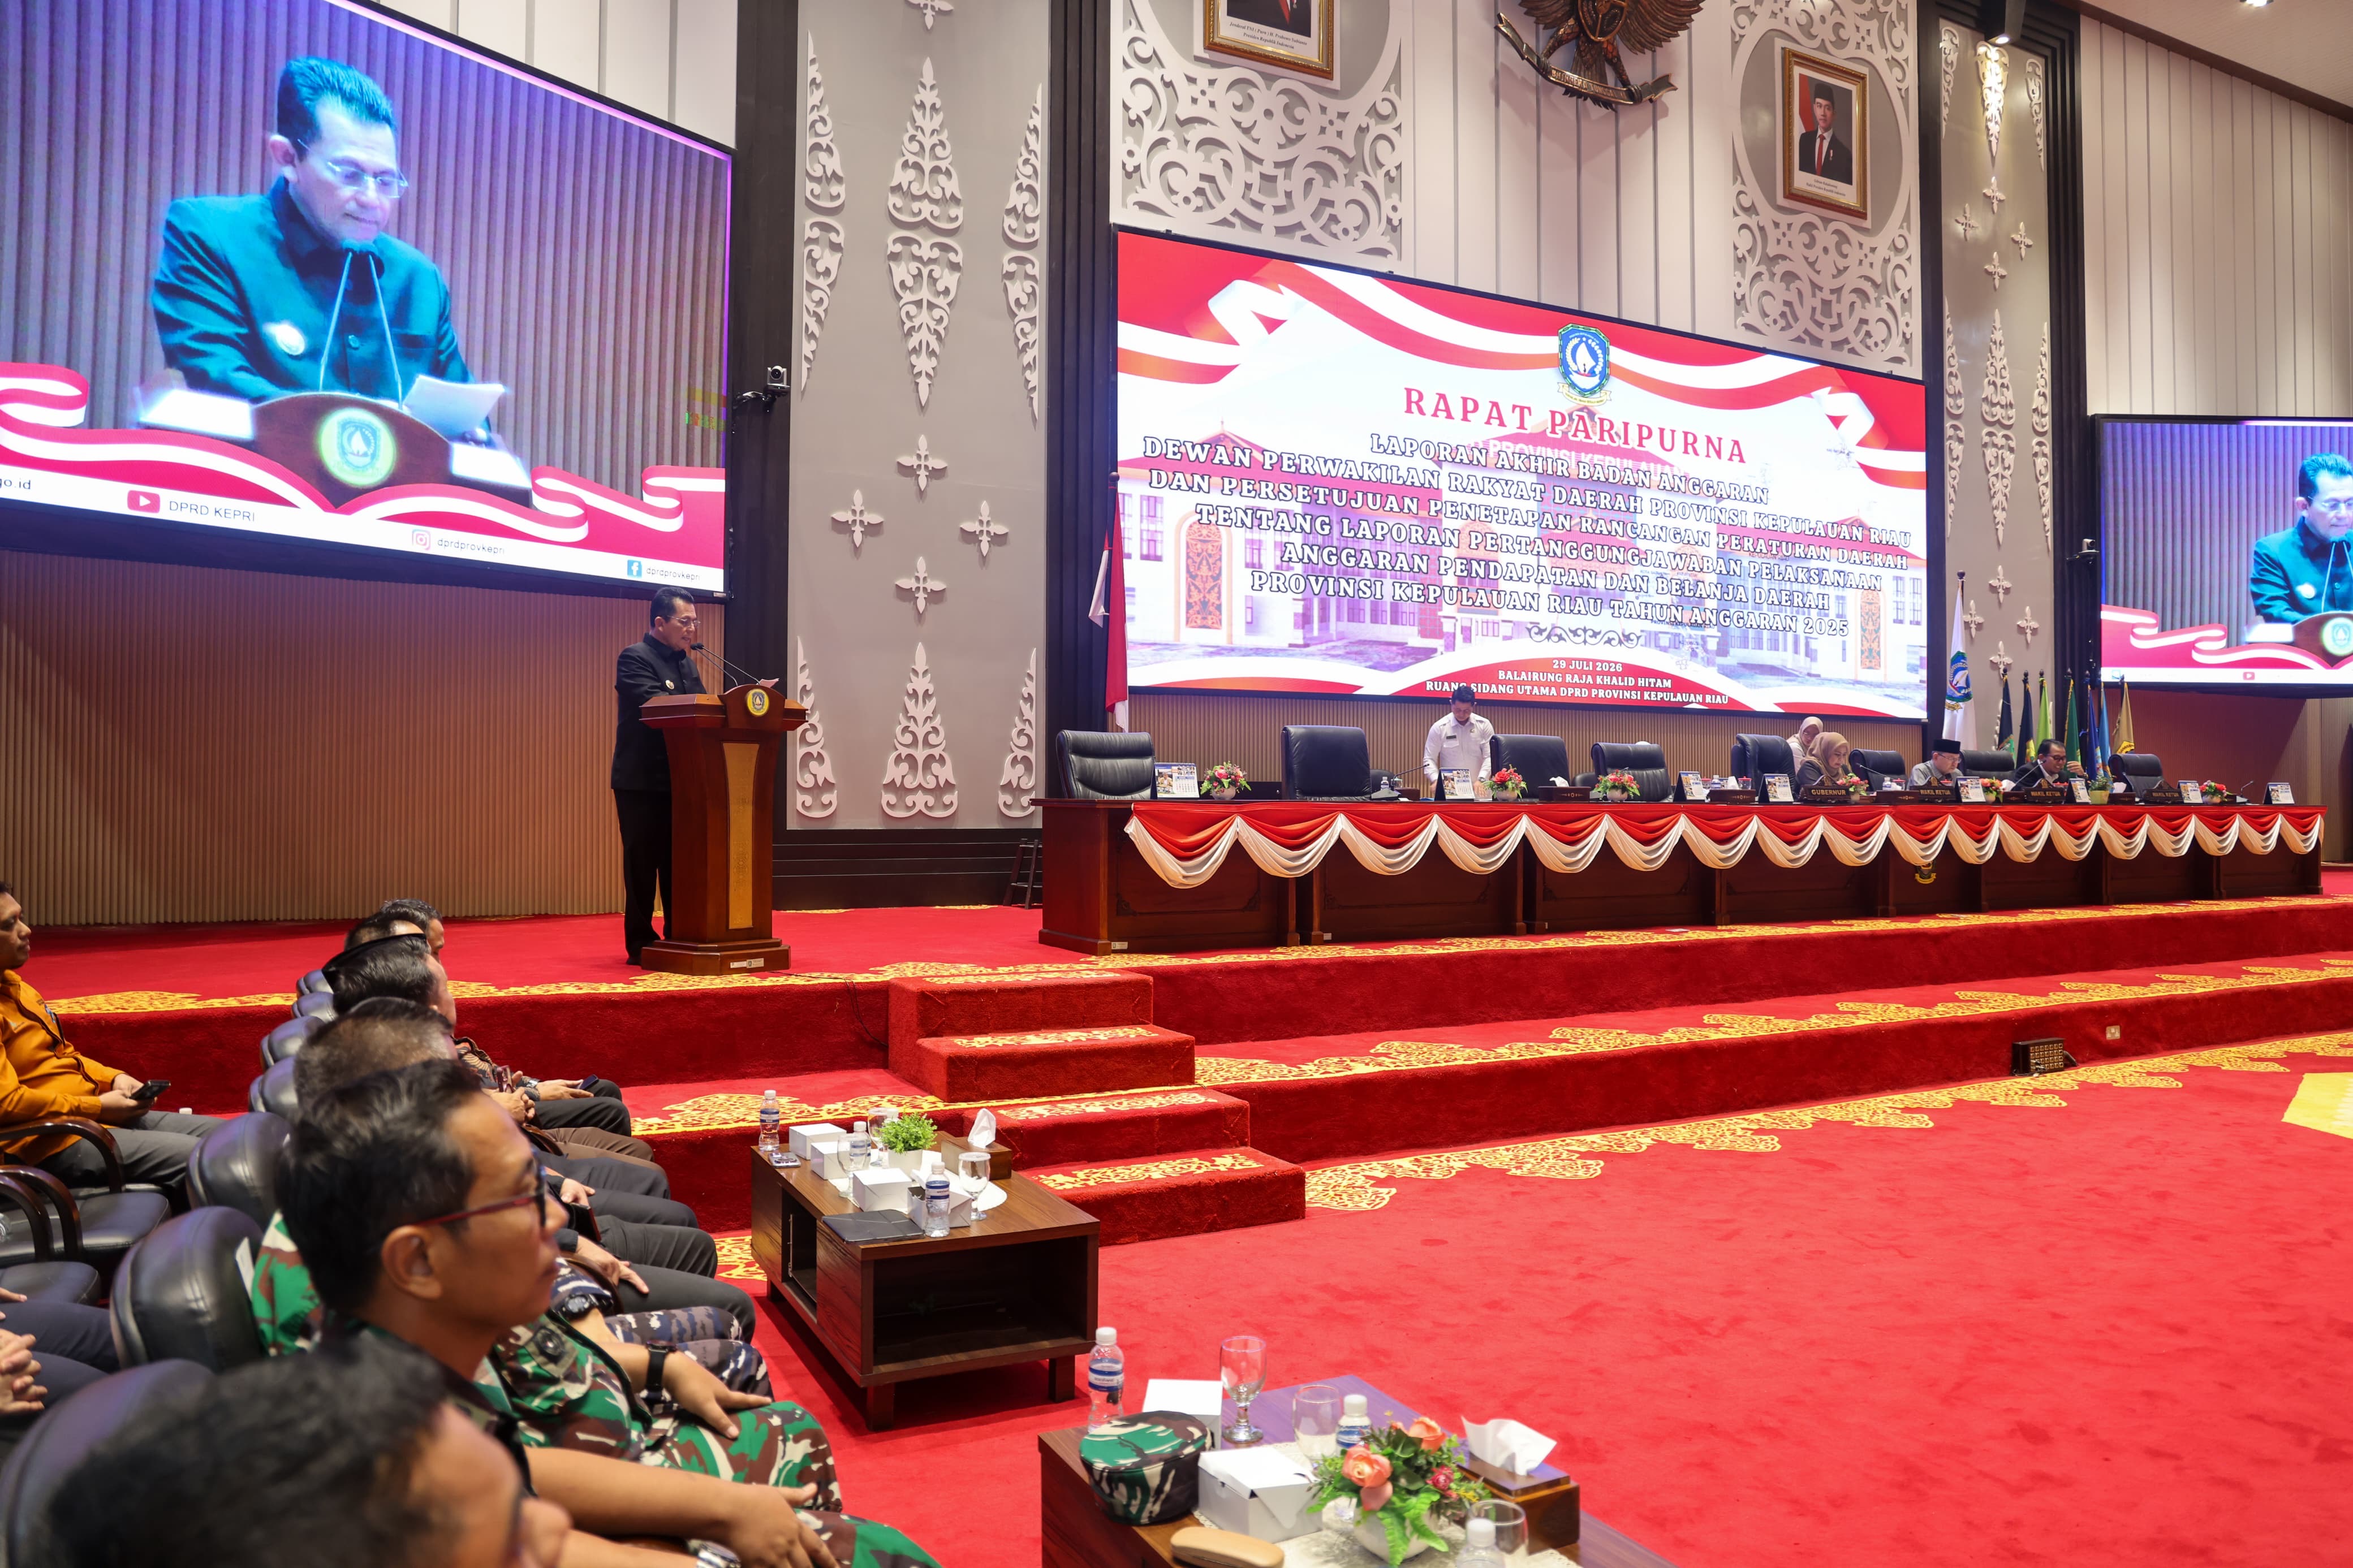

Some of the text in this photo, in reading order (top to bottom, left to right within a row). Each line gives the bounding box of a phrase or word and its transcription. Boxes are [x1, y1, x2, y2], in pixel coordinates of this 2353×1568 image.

[1243, 32, 1259, 41] Presiden
[1275, 33, 1291, 41] Prabowo
[1404, 387, 1746, 464] RAPAT PARIPURNA
[1371, 434, 1769, 504] LAPORAN AKHIR BADAN ANGGARAN
[169, 500, 255, 522] DPRD KEPRI
[1144, 437, 1912, 547] DEWAN PERWAKILAN RAKYAT DAERAH PROVINSI KEPULAUAN RIAU
[1149, 469, 1908, 571] DAN PERSETUJUAN PENETAPAN RANCANGAN PERATURAN DAERAH
[438, 538, 505, 555] dprdprovkepri
[1196, 503, 1882, 592] TENTANG LAPORAN PERTANGGUNGJAWABAN PELAKSANAAN
[1282, 542, 1830, 611] ANGGARAN PENDAPATAN DAN BELANJA DAERAH
[1251, 571, 1850, 637] PROVINSI KEPULAUAN RIAU TAHUN ANGGARAN 2025
[1498, 670, 1672, 688] BALAIRUNG RAJA KHALID HITAM
[1553, 659, 1623, 672] 29 JULI 2026
[1471, 683, 1514, 694] SIDANG
[1517, 686, 1557, 697] UTAMA
[1560, 688, 1589, 698] DPRD
[1591, 689, 1641, 700] PROVINSI
[1643, 691, 1703, 703] KEPULAUAN
[1705, 693, 1729, 704] RIAU
